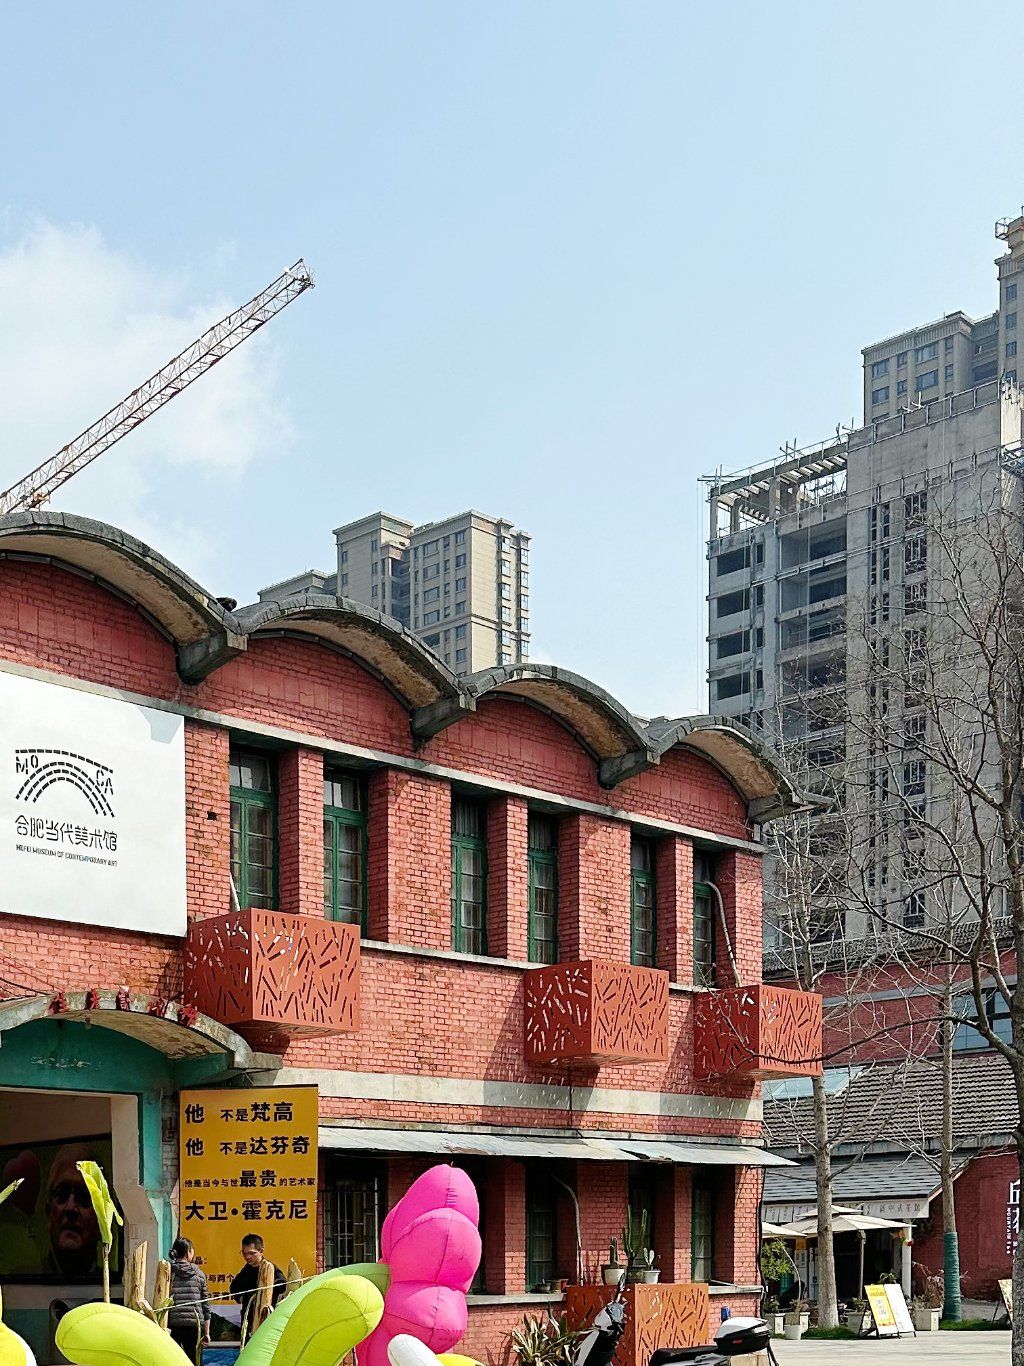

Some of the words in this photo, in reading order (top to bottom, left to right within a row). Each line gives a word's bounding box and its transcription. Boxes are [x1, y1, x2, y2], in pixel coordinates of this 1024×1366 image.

[15, 815, 118, 851] 合肥当代美术馆
[16, 844, 32, 853] HEFEI
[32, 846, 56, 857] MUSEUM
[57, 850, 64, 858] OF
[184, 1103, 205, 1123] 他
[220, 1102, 293, 1122] 不是梵高
[184, 1137, 204, 1156] 他
[219, 1136, 311, 1155] 不是达芬奇
